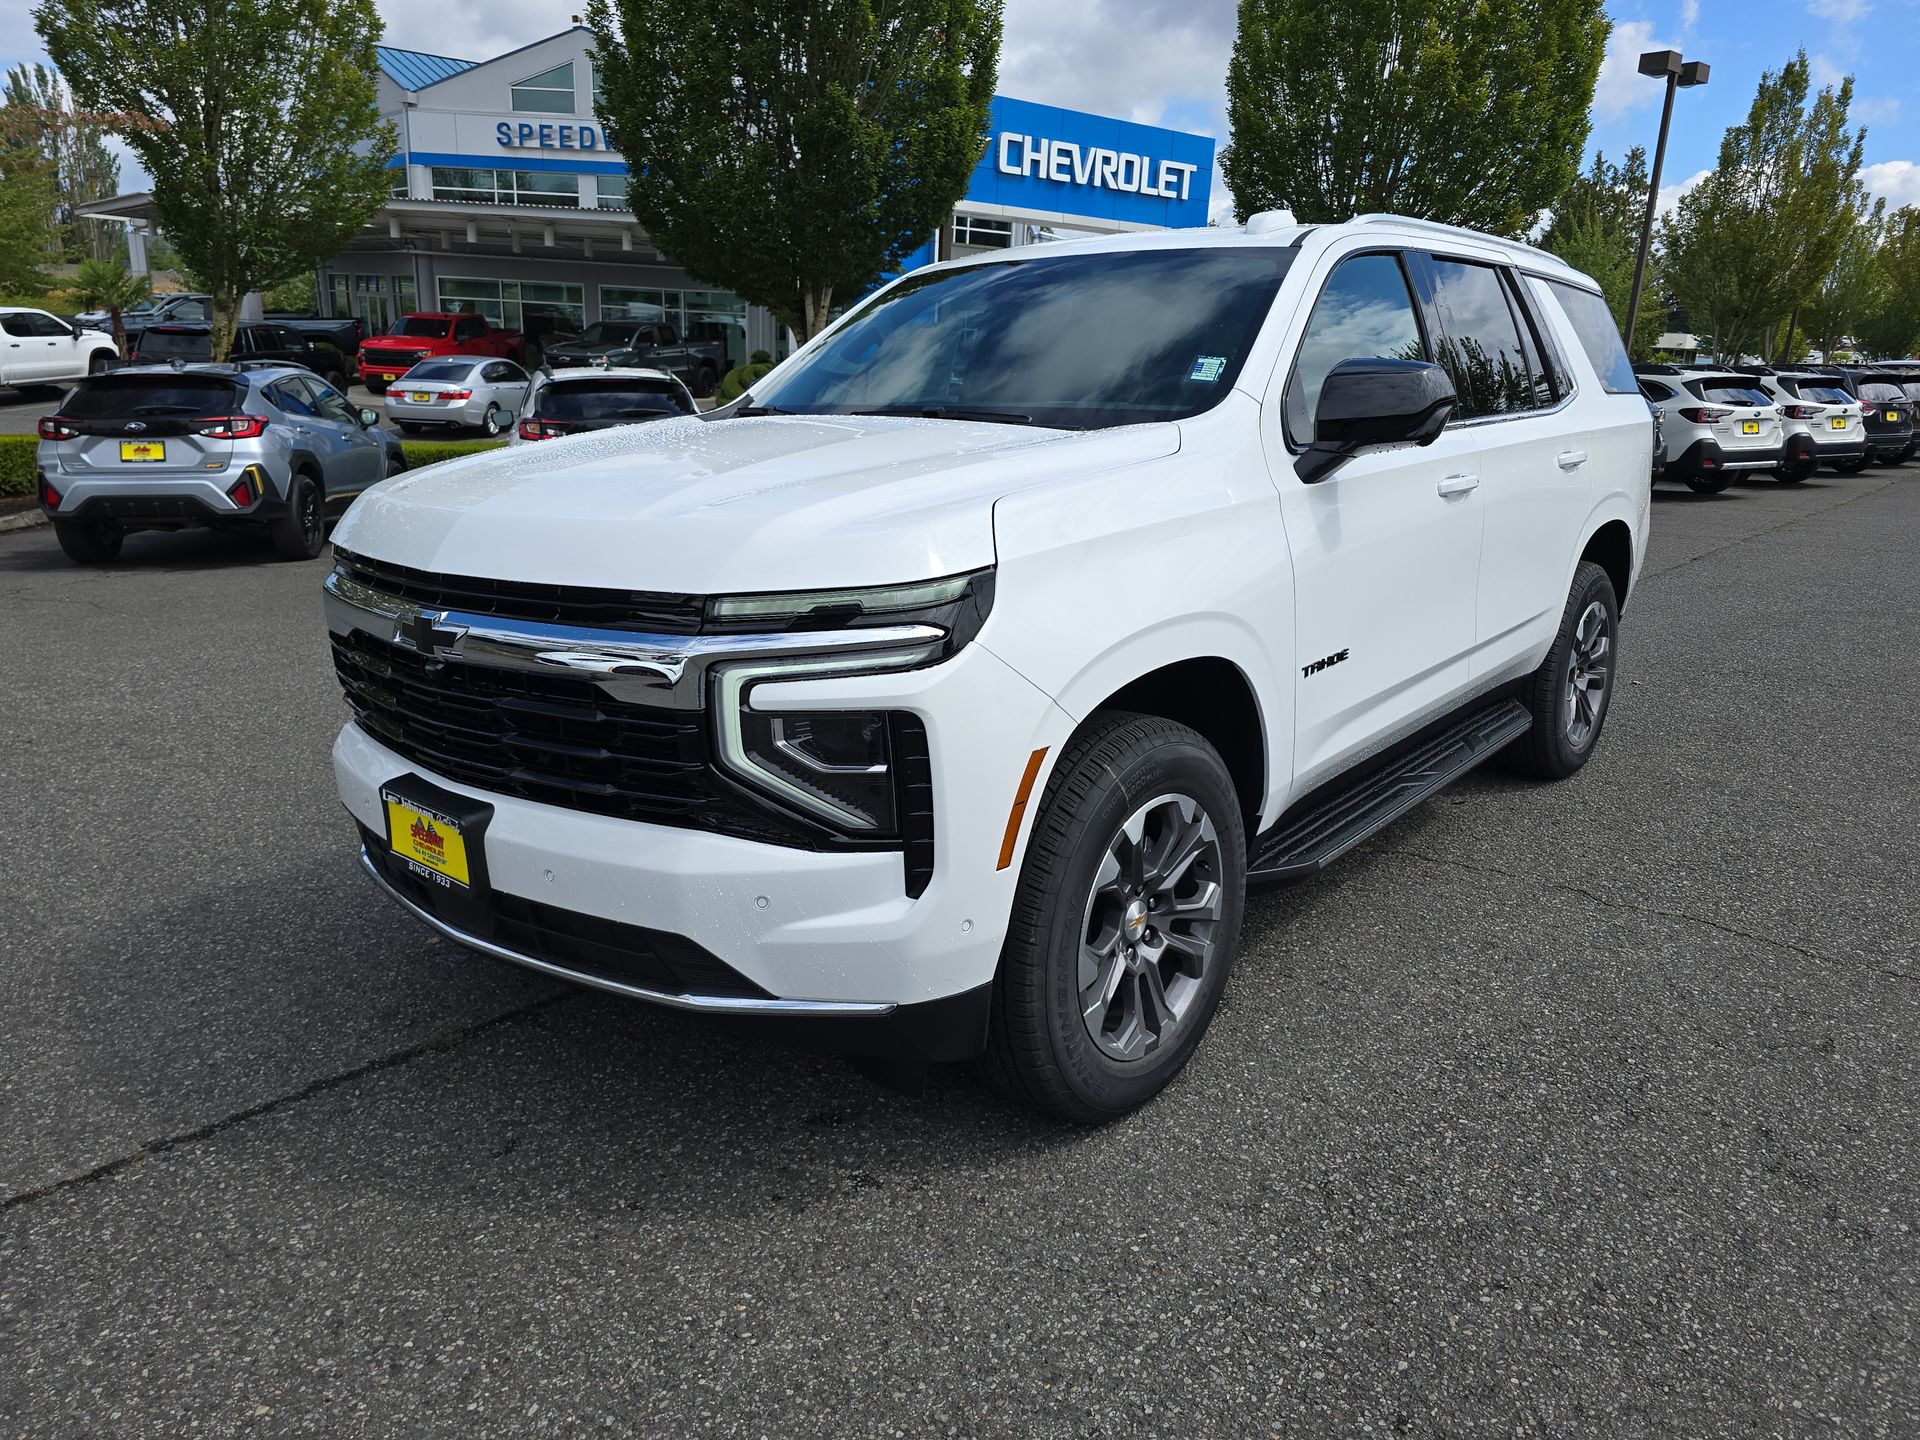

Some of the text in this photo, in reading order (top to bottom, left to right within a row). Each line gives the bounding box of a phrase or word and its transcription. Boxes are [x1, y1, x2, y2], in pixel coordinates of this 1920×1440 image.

[999, 131, 1198, 200] CHEVROLET
[1301, 648, 1350, 679] TAHOE
[408, 862, 430, 879] SINCE
[432, 873, 451, 888] 1933
